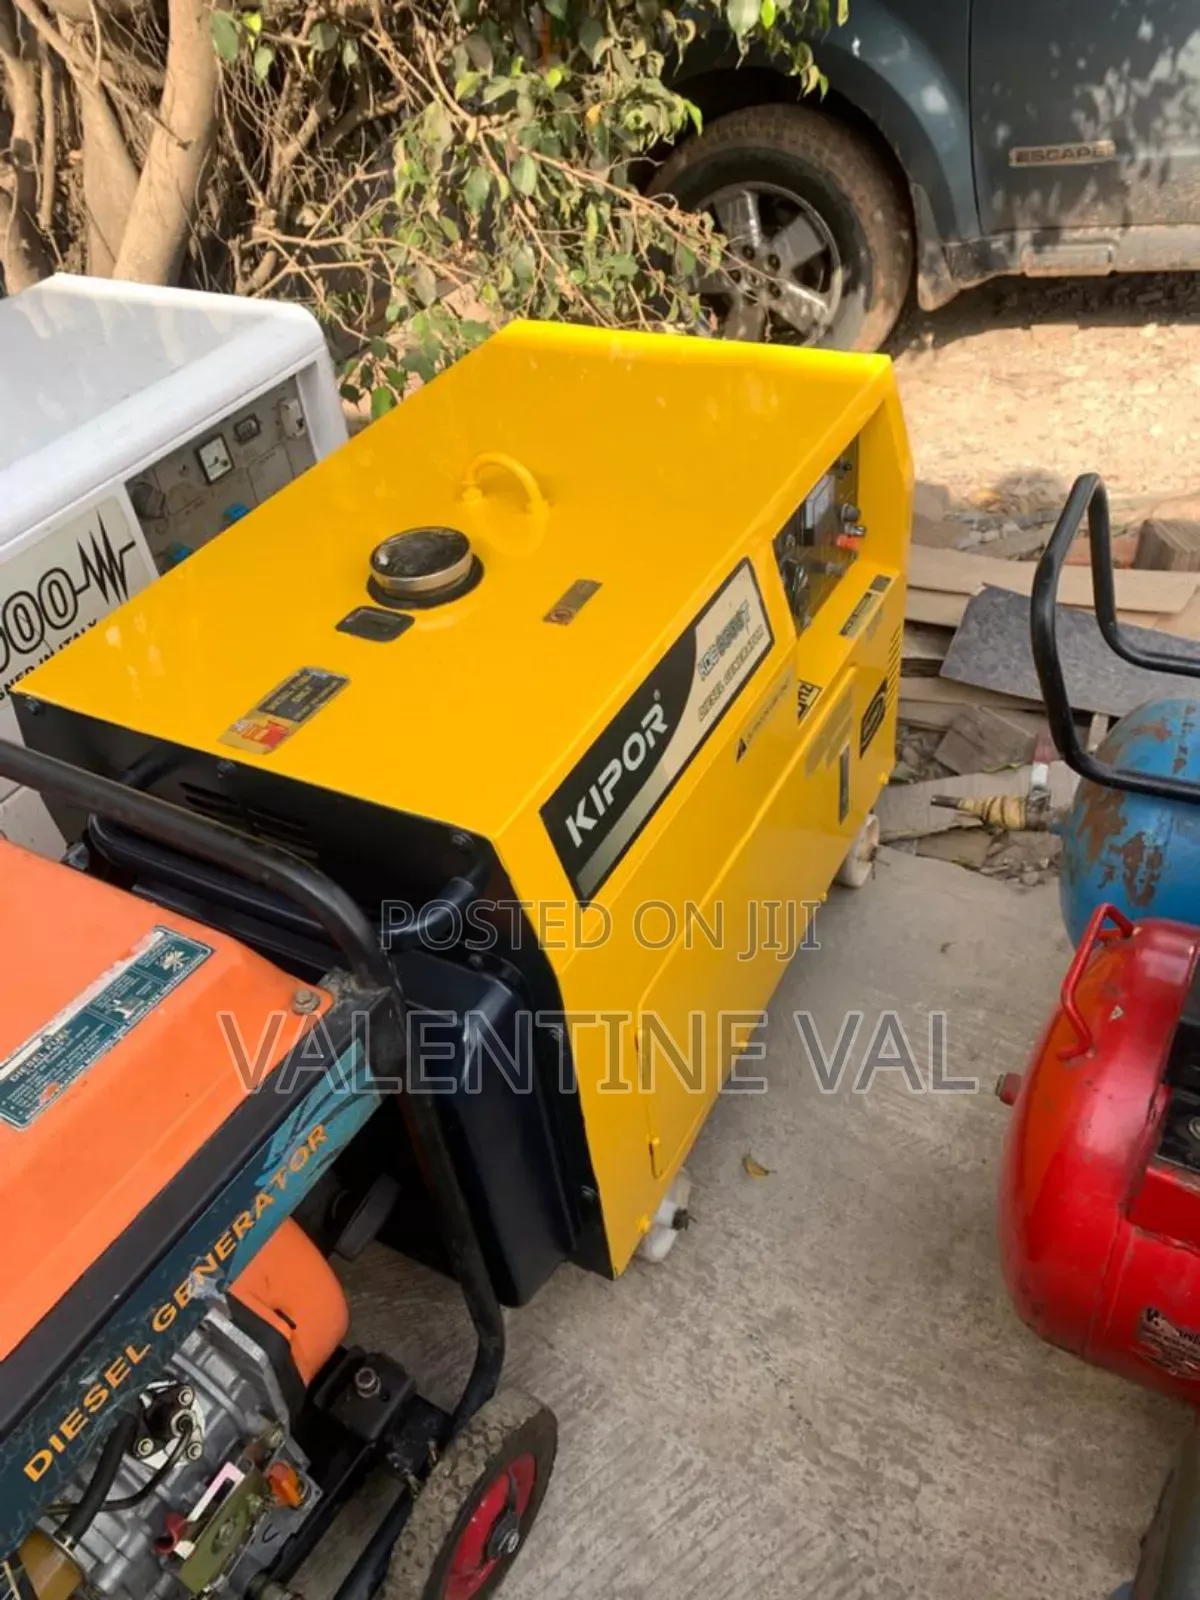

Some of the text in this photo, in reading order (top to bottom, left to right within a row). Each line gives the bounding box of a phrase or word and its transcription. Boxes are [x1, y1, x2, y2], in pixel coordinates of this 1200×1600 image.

[1016, 146, 1106, 163] ESCAPE
[0, 567, 78, 674] 00
[565, 703, 669, 848] KIPOR
[24, 1125, 328, 1482] DIESEL GENERATOR
